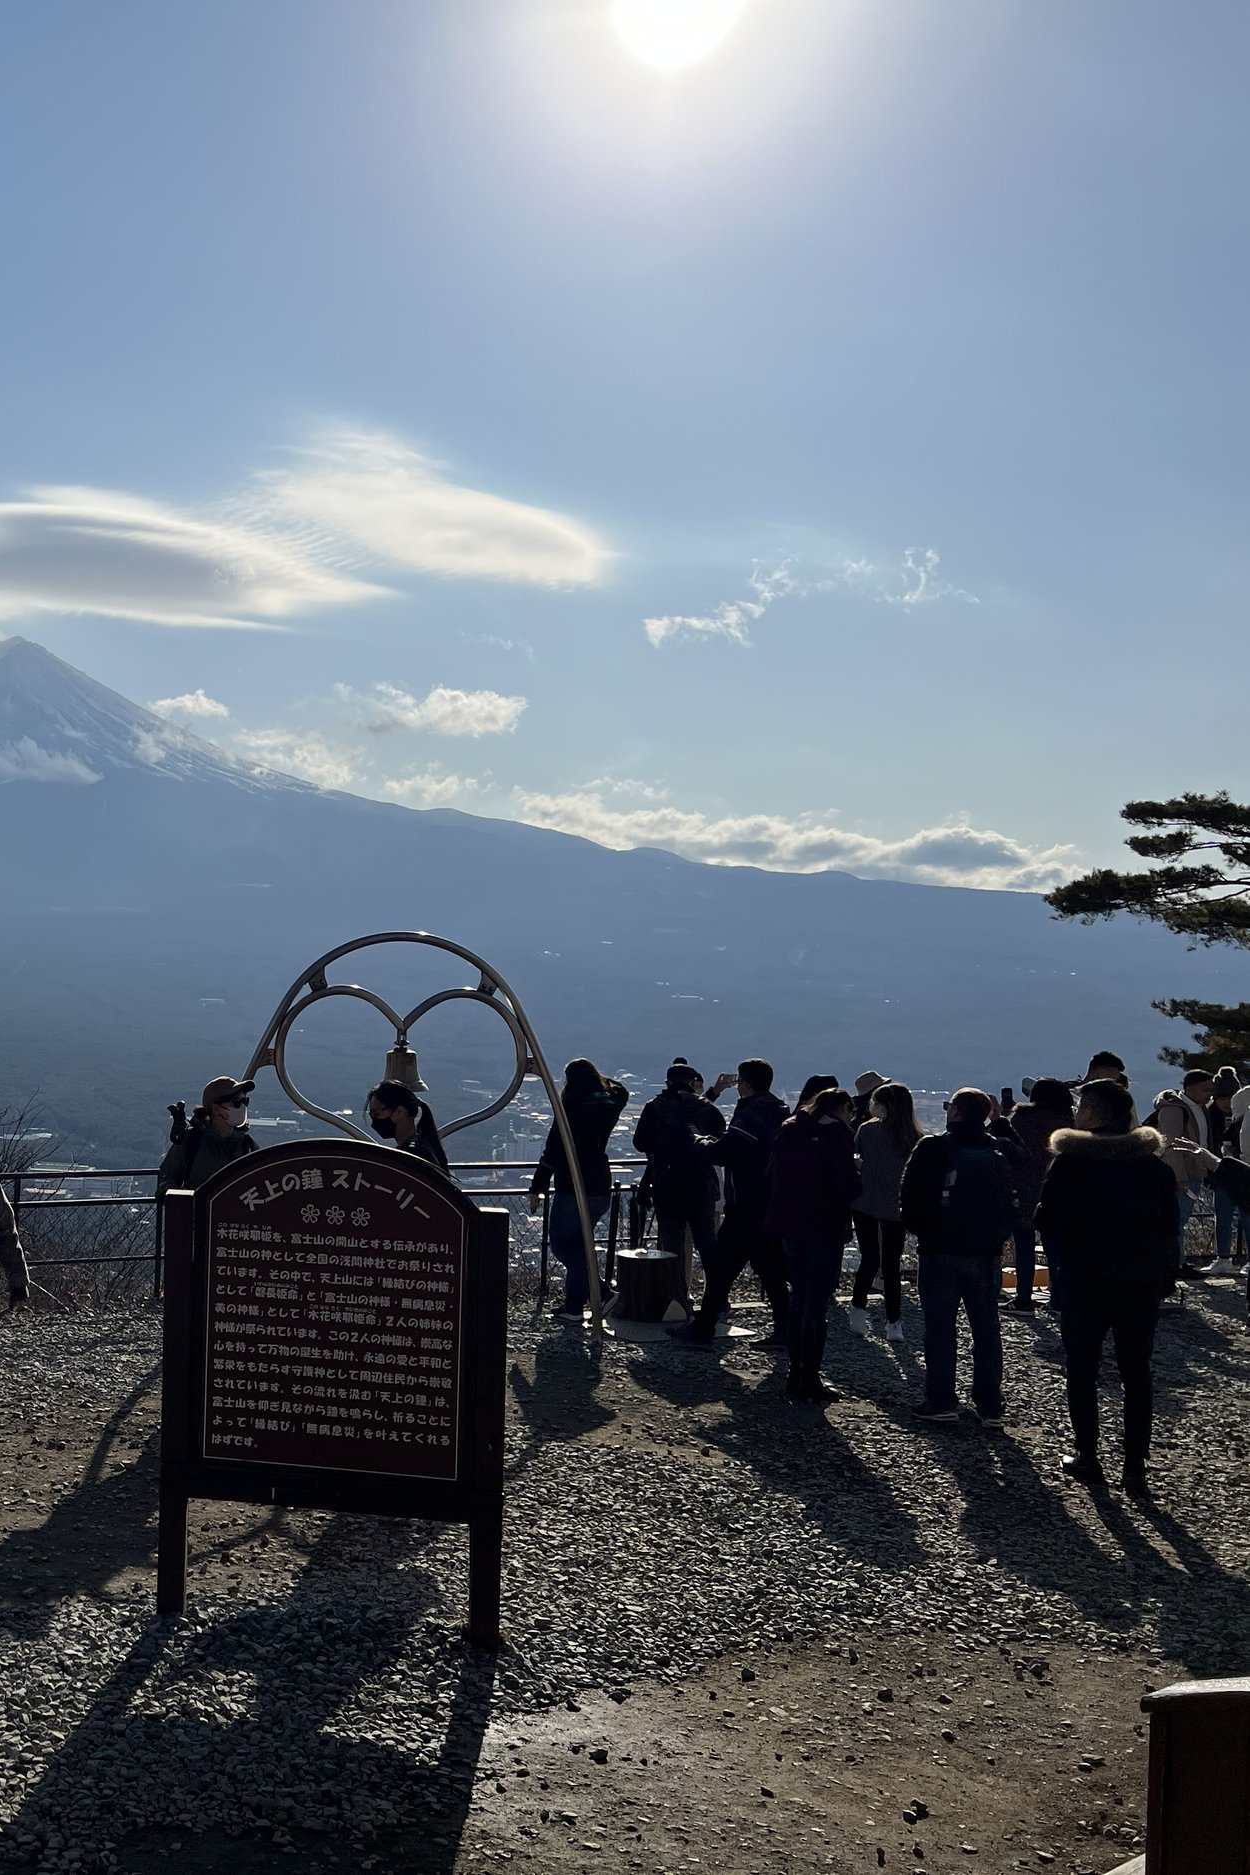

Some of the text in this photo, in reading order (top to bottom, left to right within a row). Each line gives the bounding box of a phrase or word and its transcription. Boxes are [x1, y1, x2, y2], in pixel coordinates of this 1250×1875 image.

[239, 1168, 430, 1220] 天上の鐘 ストーリー
[211, 1433, 258, 1448] はずです。
